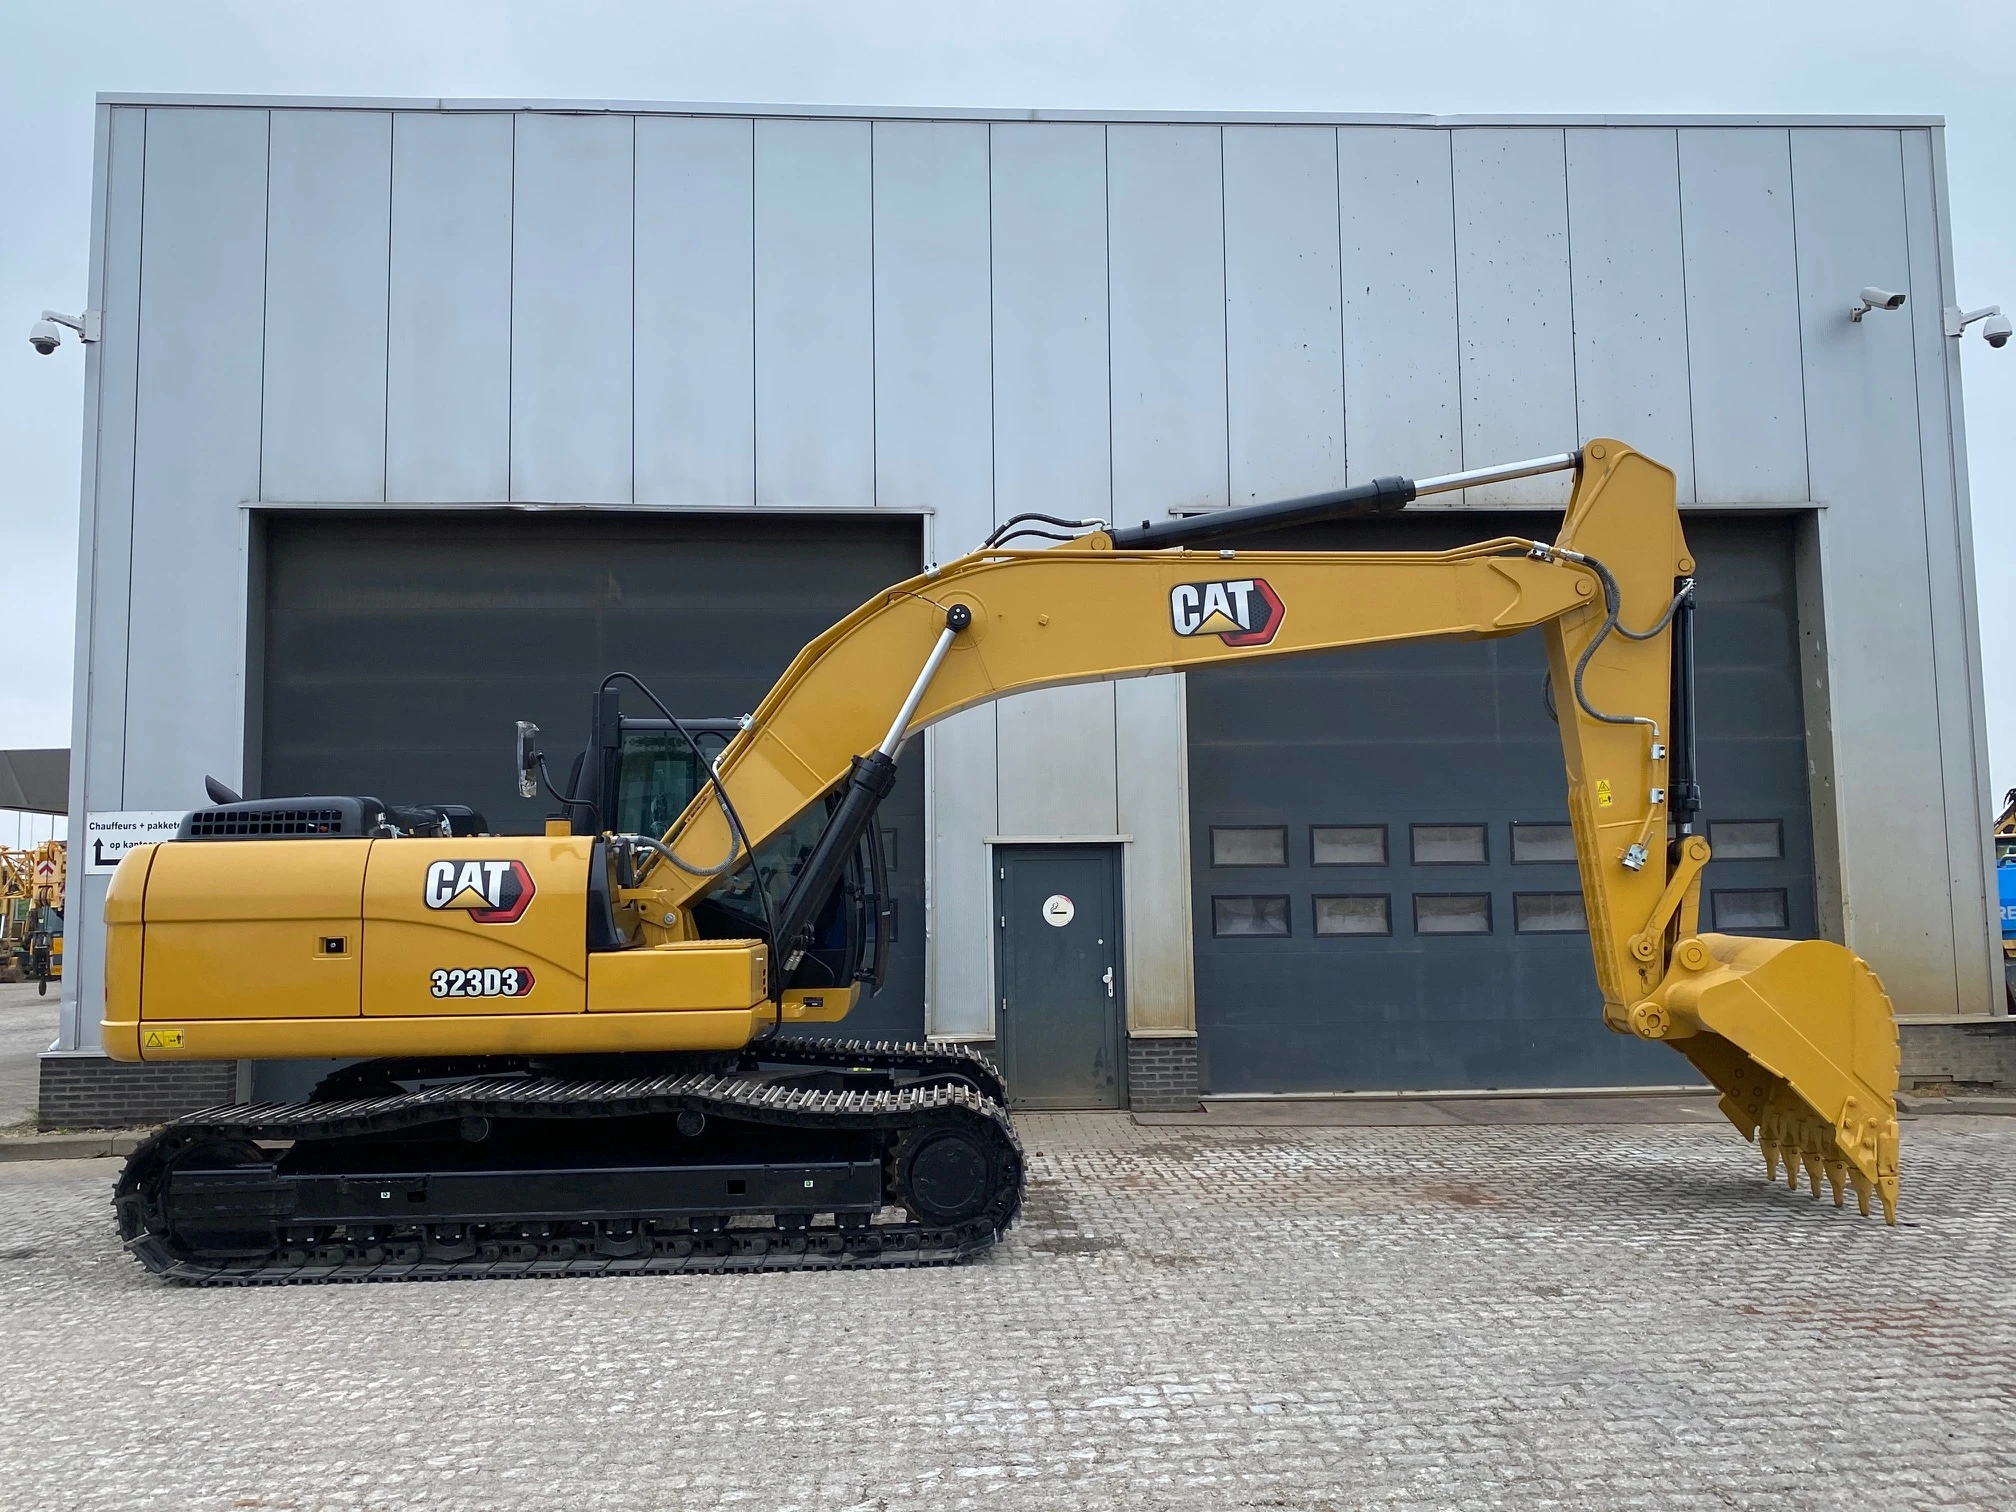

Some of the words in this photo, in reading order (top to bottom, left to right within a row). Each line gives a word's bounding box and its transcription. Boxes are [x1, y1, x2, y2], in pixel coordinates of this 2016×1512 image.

[1171, 580, 1255, 635] CAT
[89, 821, 137, 831] Chauffeurs
[109, 842, 121, 851] op
[426, 861, 511, 908] CAT
[431, 968, 519, 996] 323D3
